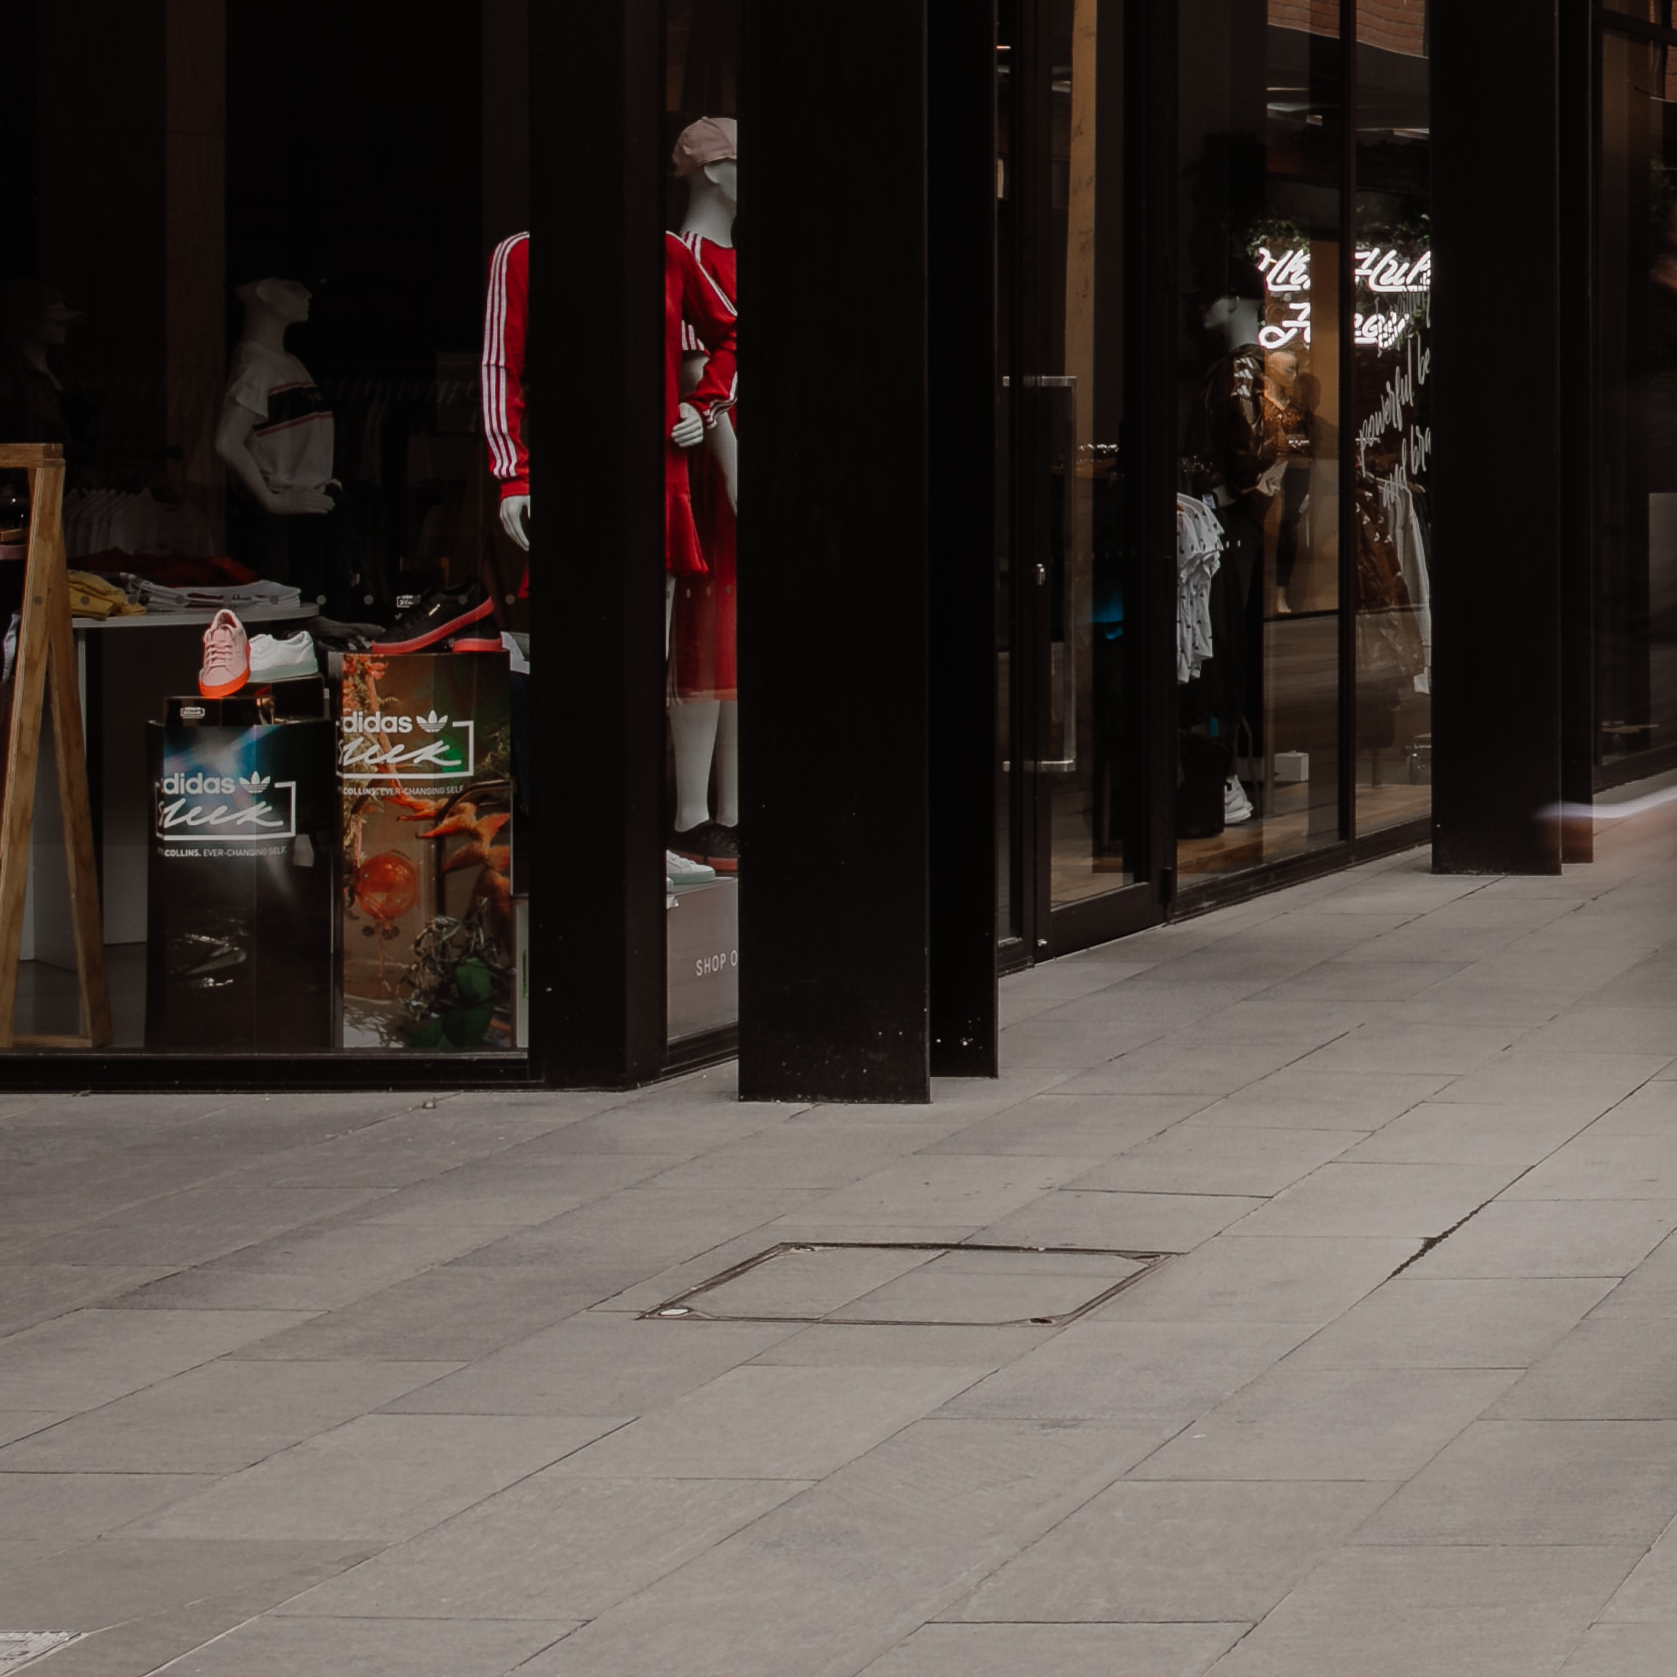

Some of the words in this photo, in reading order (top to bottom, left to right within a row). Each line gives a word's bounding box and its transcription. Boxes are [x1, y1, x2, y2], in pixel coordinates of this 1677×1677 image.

[341, 710, 413, 733] didas
[160, 772, 236, 795] didas
[695, 952, 726, 977] SHOP
